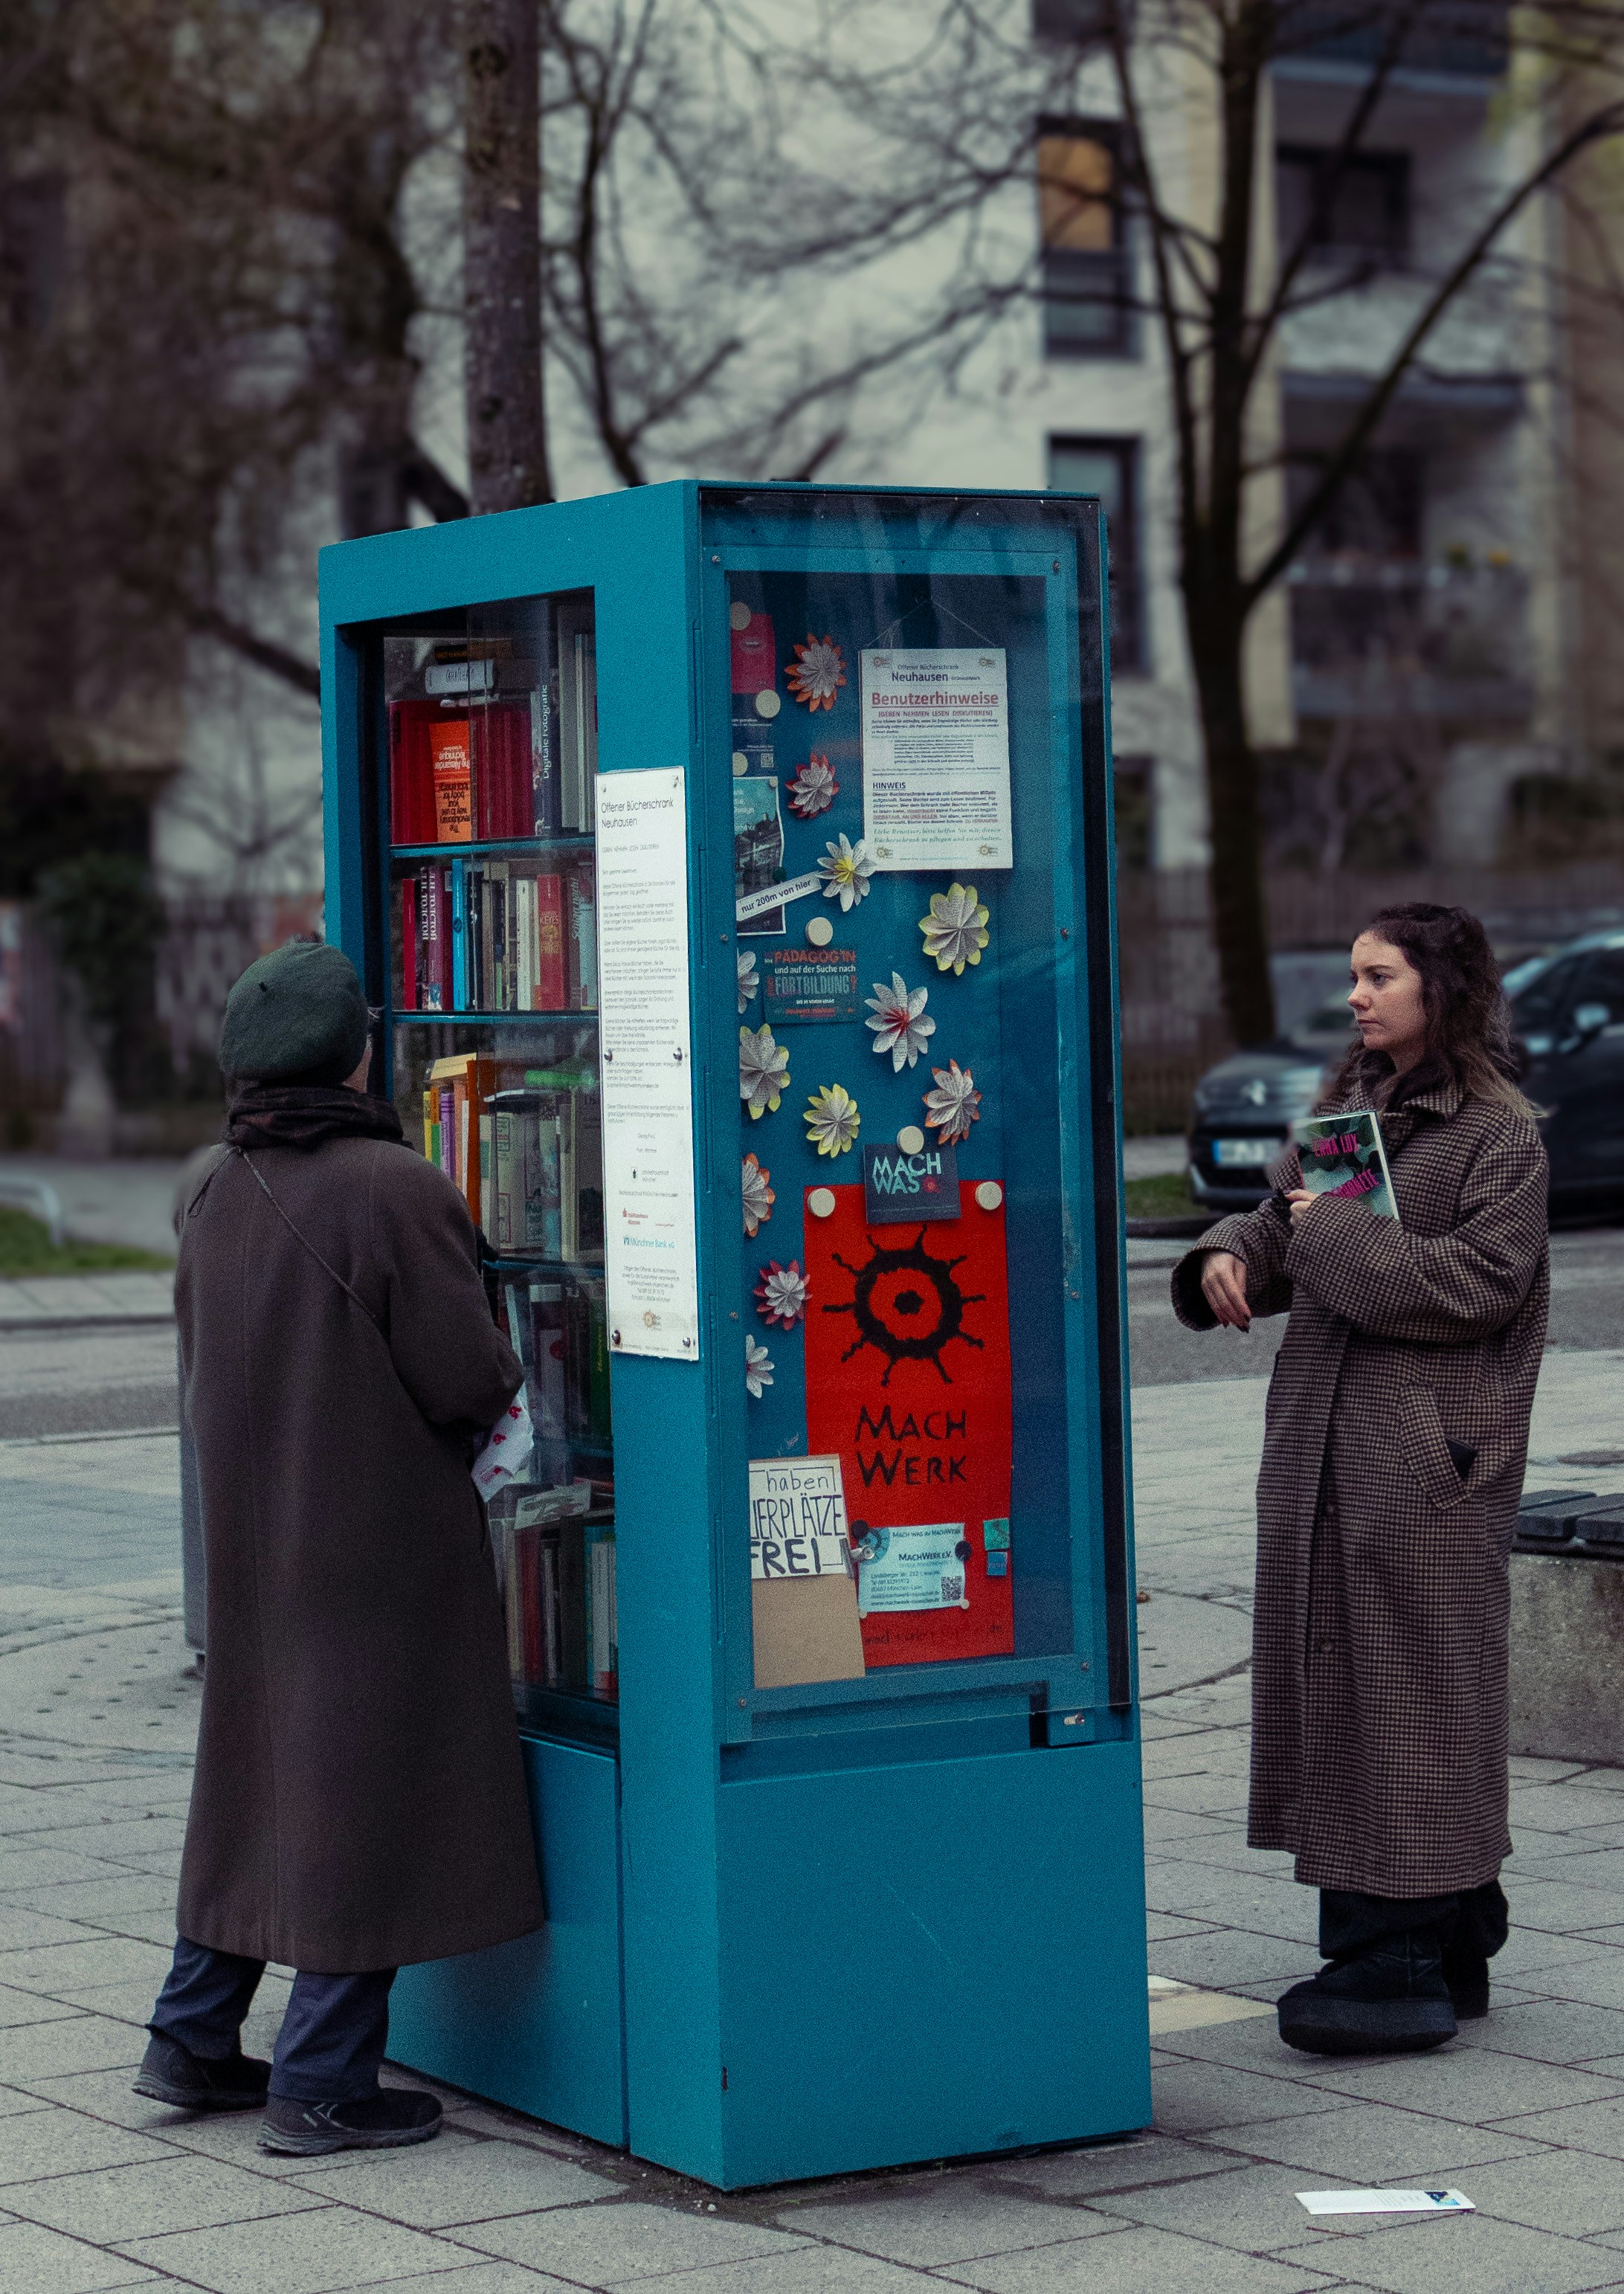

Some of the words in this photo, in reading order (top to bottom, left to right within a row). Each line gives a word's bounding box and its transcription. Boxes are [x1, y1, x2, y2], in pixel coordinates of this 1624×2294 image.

[892, 672, 948, 682] Neuhausen
[871, 692, 999, 705] Benutzerhinweise
[541, 684, 550, 736] Fotografie
[542, 739, 552, 779] Digitale
[602, 802, 625, 813] Offener
[627, 799, 674, 811] Bücherschrank
[602, 818, 637, 828] Neuhausen
[741, 903, 755, 913] nur
[756, 893, 778, 907] 200m
[779, 888, 794, 897] von
[796, 879, 811, 892] hier
[1340, 1134, 1359, 1153] LUX
[873, 1153, 941, 1176] MACH
[873, 1173, 920, 1194] WAS
[855, 1405, 966, 1443] MACH
[857, 1449, 967, 1487] WERK
[767, 1471, 829, 1492] haben
